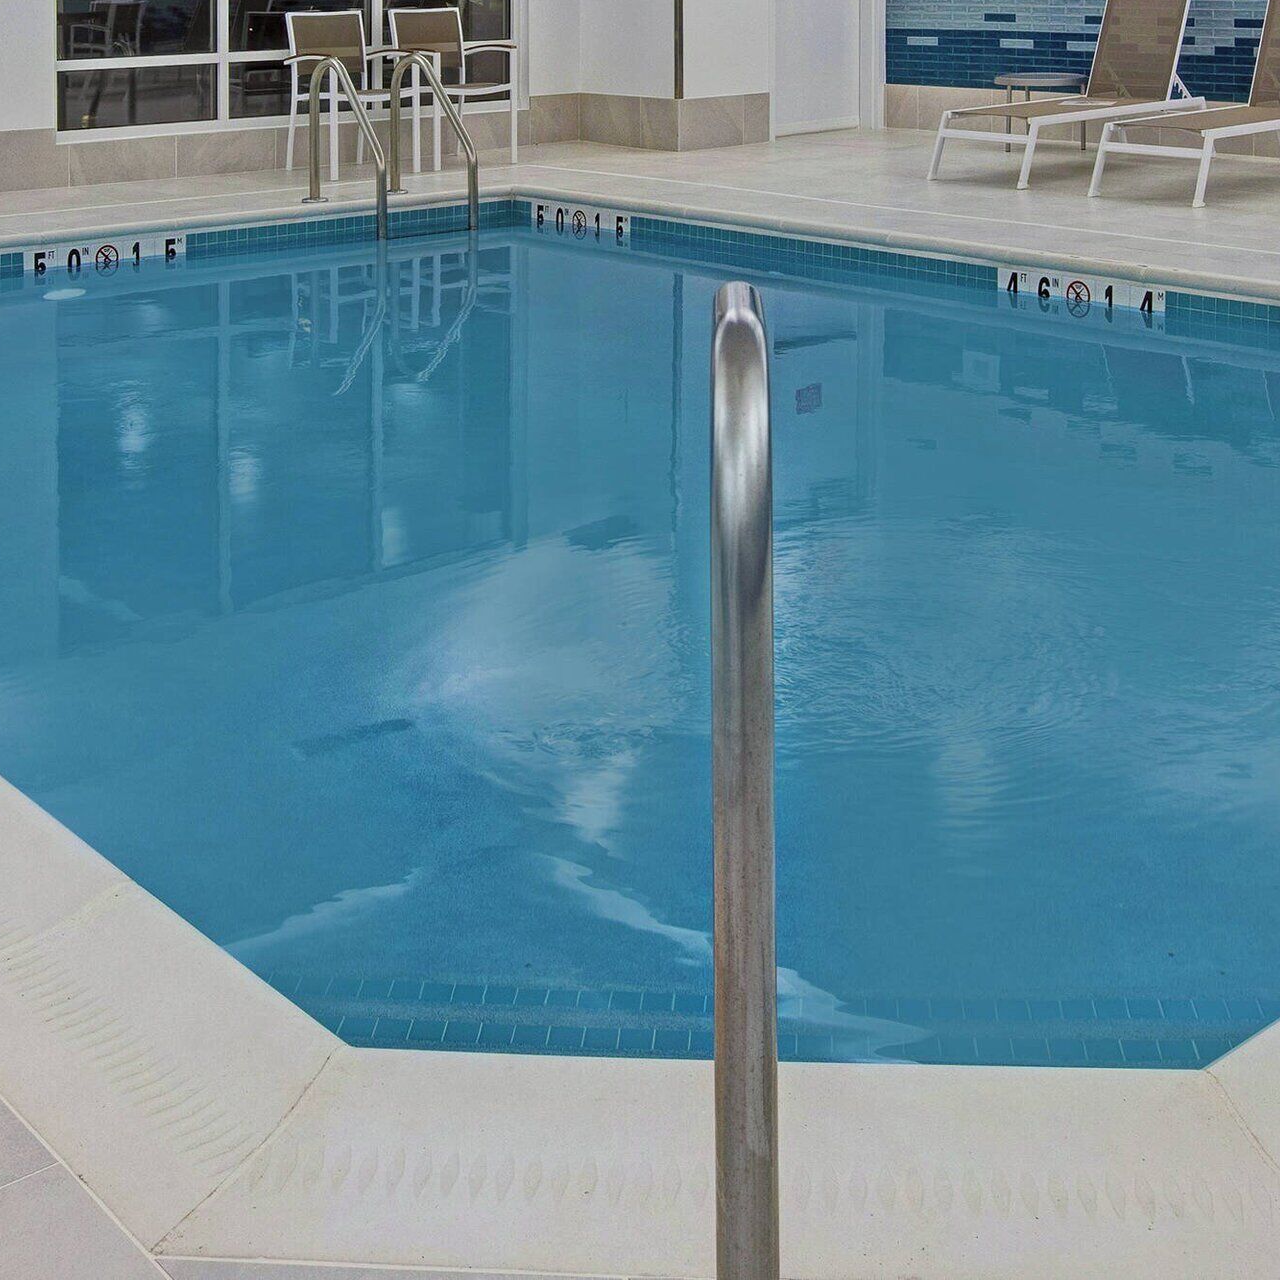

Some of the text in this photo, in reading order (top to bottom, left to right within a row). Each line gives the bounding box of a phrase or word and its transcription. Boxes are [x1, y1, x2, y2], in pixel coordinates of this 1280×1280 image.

[48, 250, 55, 259] FT
[82, 247, 89, 256] IN
[1021, 273, 1027, 283] FT
[1038, 276, 1050, 298] 6
[1052, 278, 1059, 288] IN
[1158, 292, 1164, 301] M
